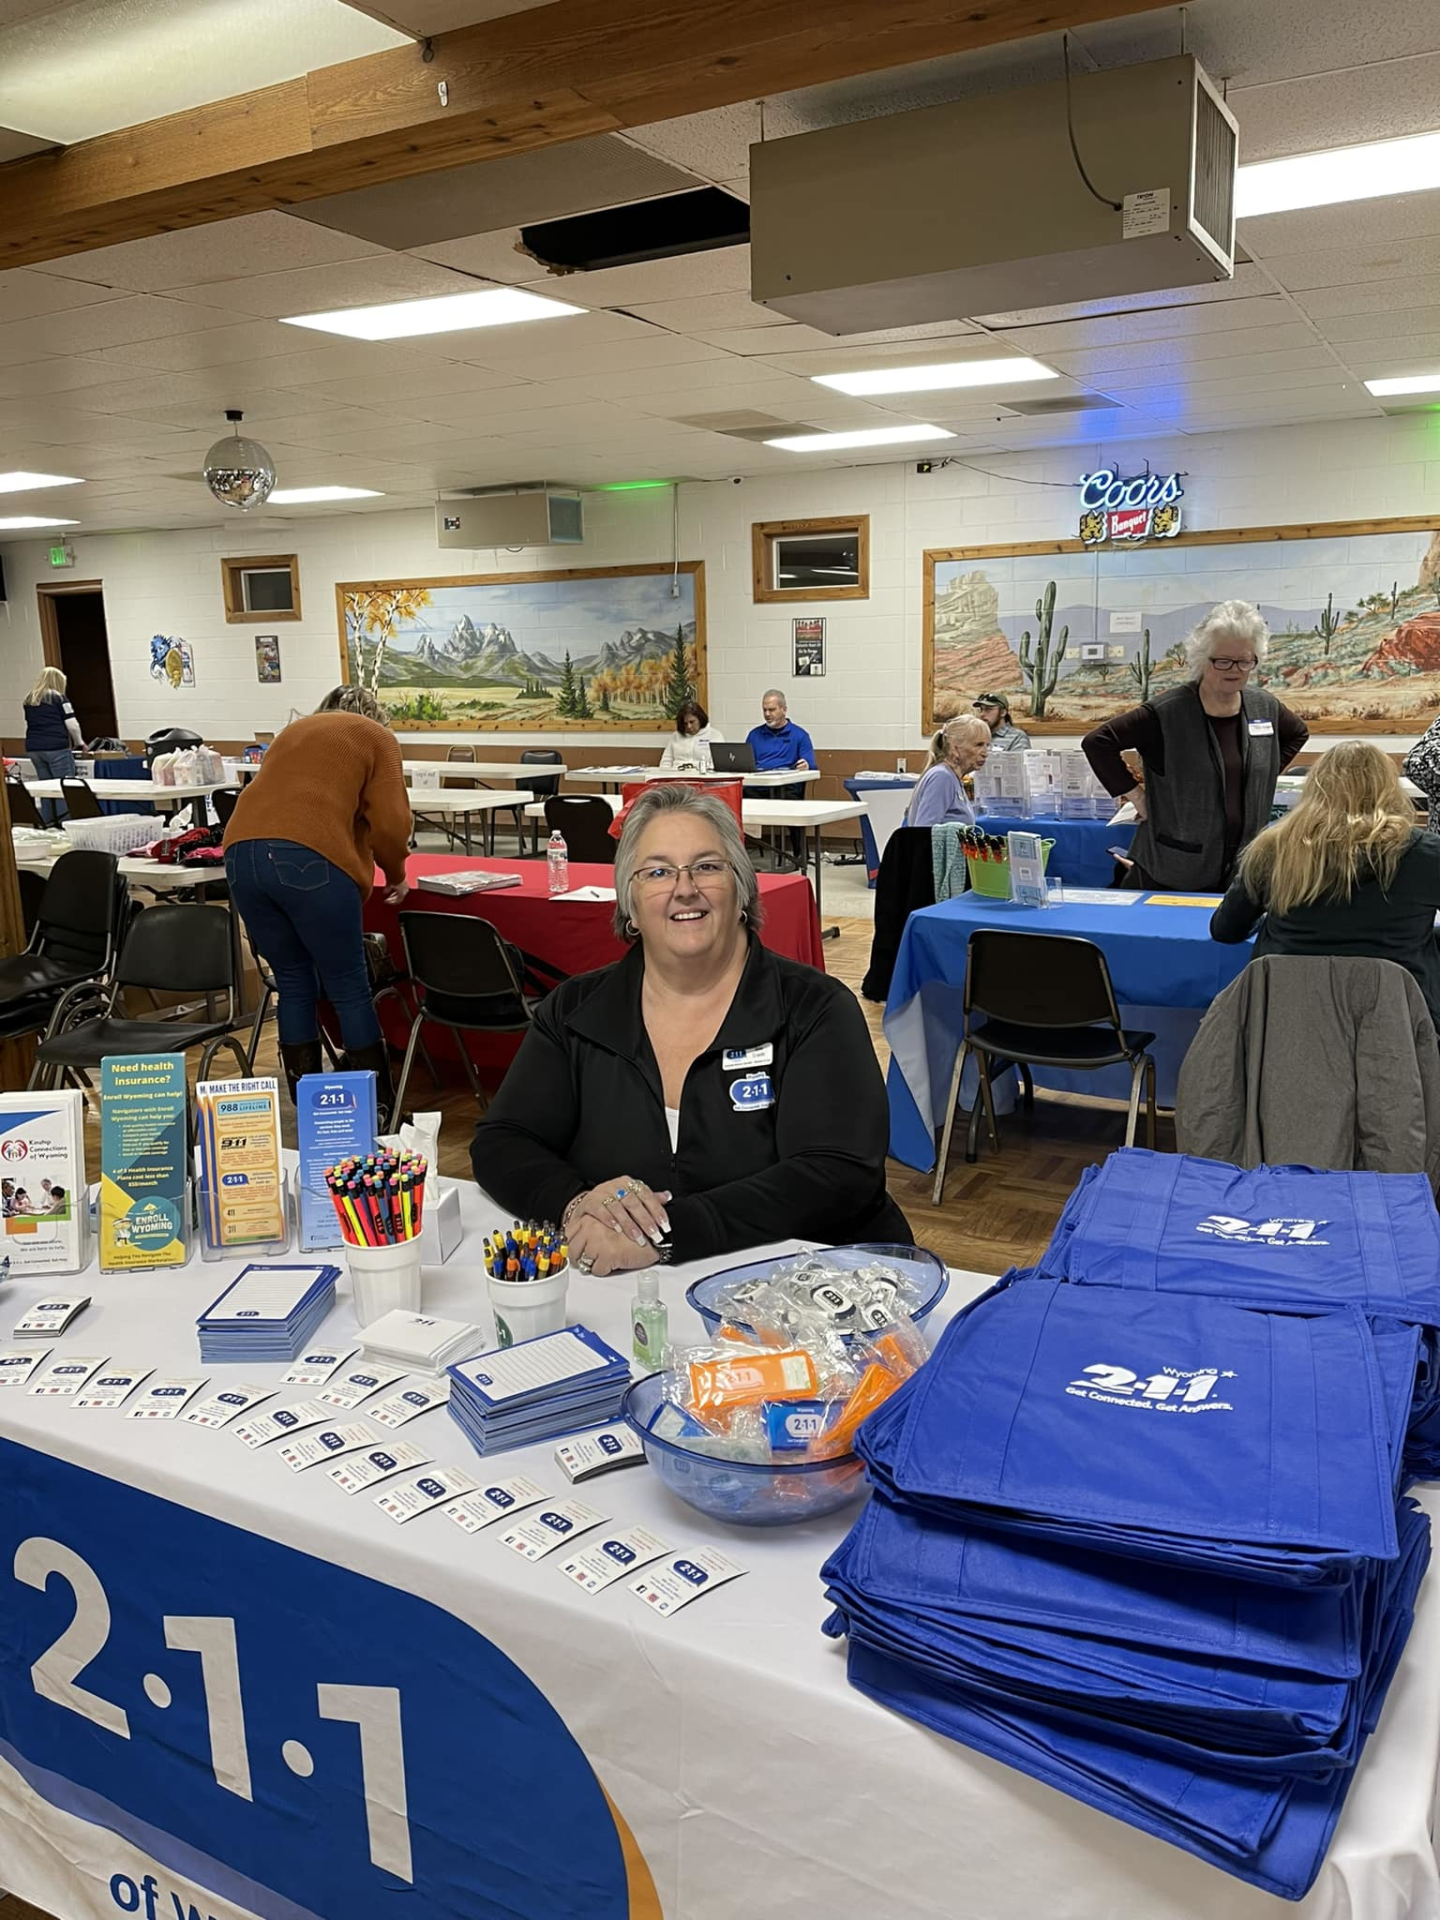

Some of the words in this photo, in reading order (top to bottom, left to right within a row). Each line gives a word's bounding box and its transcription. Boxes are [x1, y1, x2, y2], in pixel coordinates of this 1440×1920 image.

[1080, 470, 1182, 509] Coors
[1111, 512, 1147, 535] Banquet
[111, 1063, 138, 1073] Need
[141, 1061, 174, 1071] health
[115, 1075, 171, 1086] insurance?
[209, 1084, 227, 1094] MAKE
[228, 1083, 240, 1092] THE
[241, 1082, 260, 1091] RIGHT
[261, 1080, 276, 1089] CALL
[123, 1093, 153, 1101] Wyoming
[221, 1104, 238, 1112] 988
[136, 1213, 169, 1225] ENROLL
[131, 1221, 173, 1234] WYOMING
[1163, 1366, 1218, 1378] Wyoming
[1065, 1387, 1088, 1398] Get
[1088, 1391, 1153, 1410] Connected.
[1155, 1402, 1177, 1412] Get
[1178, 1402, 1234, 1413] Answers.
[110, 1873, 159, 1920] of
